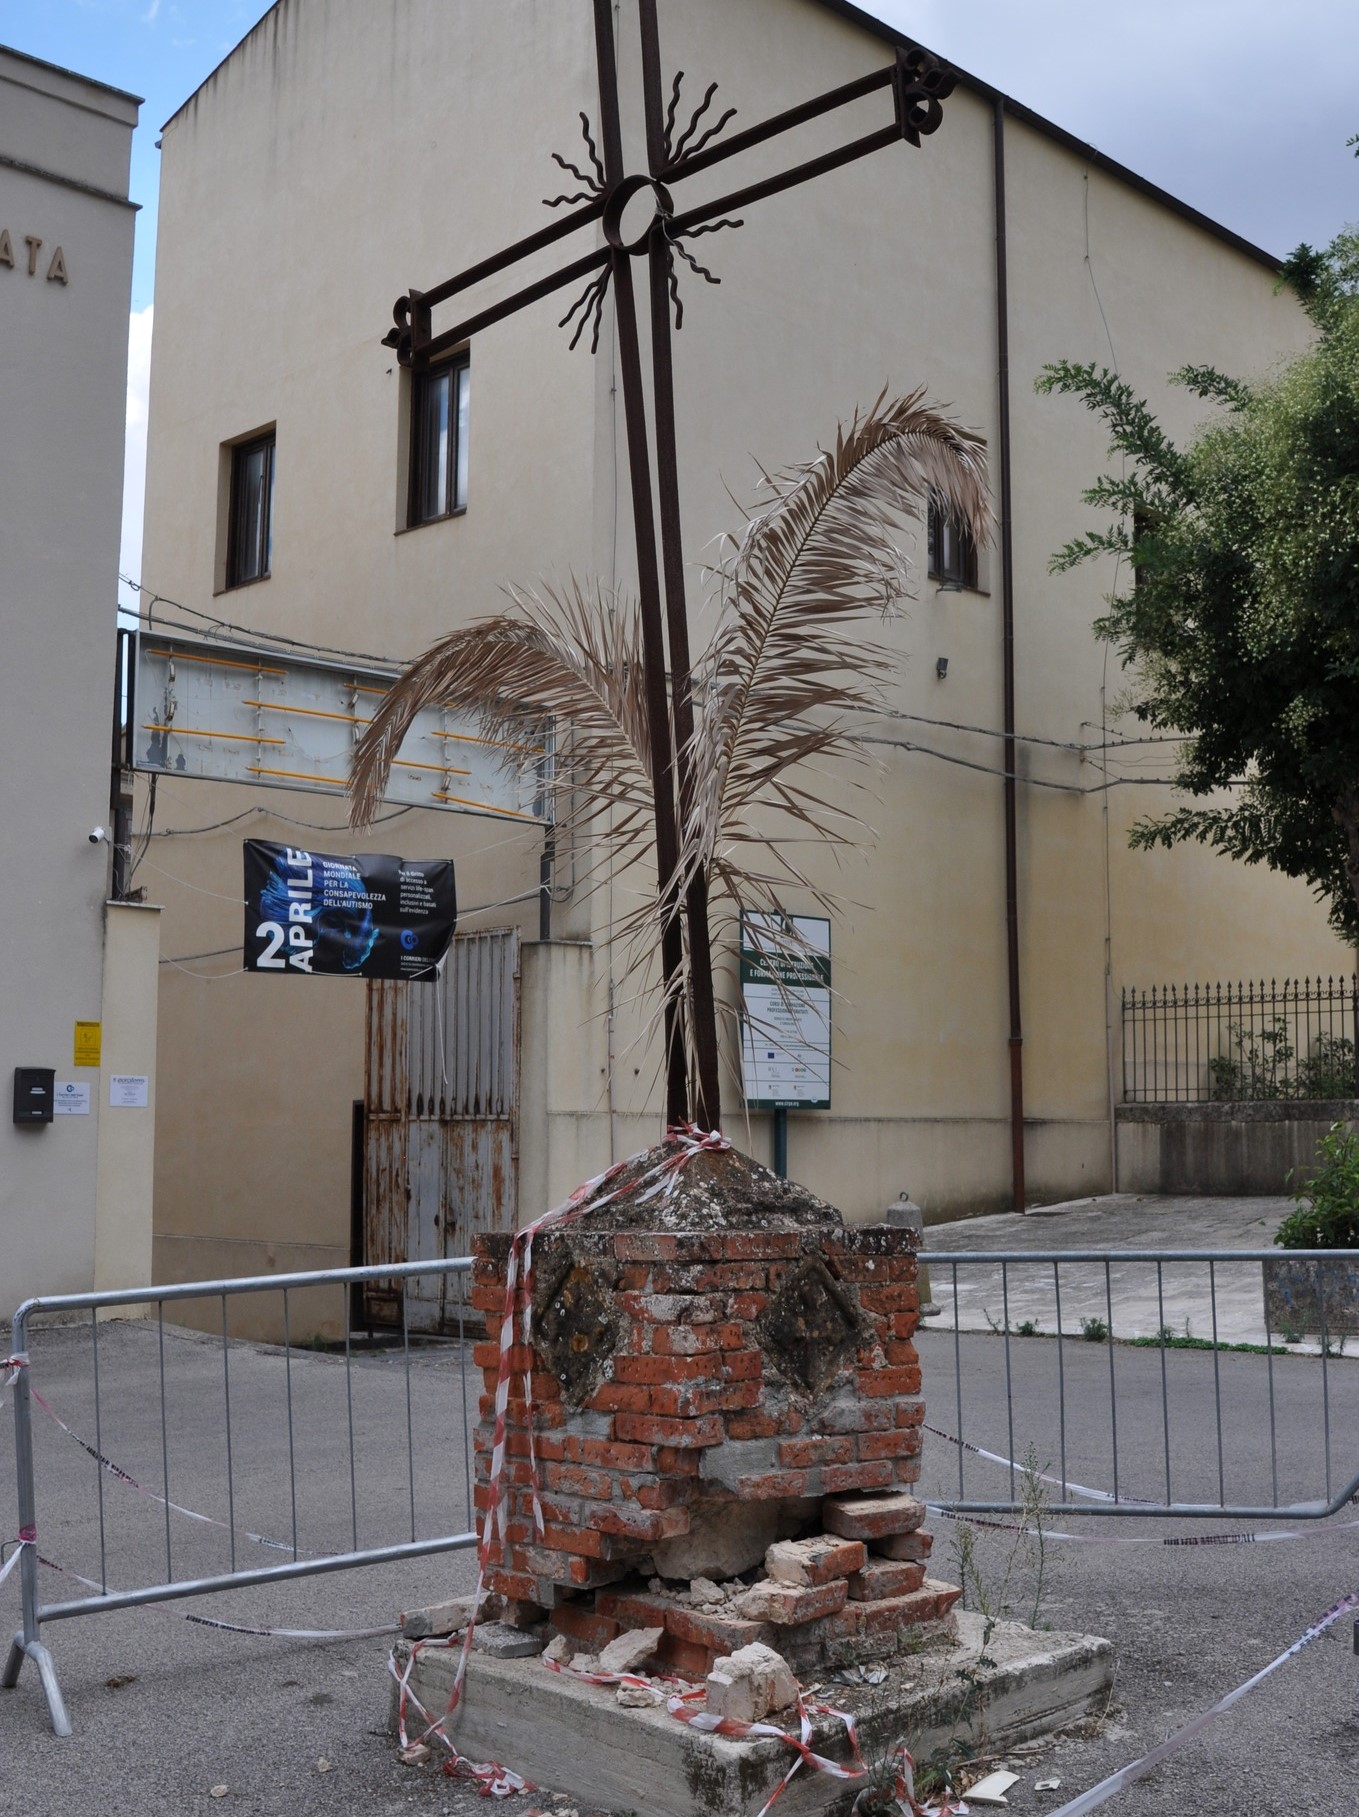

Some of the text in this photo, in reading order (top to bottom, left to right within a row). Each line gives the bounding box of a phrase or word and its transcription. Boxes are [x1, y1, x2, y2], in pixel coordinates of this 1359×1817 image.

[322, 861, 358, 872] GIORNATA
[323, 871, 361, 880] MONDIALE
[324, 880, 349, 889] PER LA
[323, 889, 387, 901] CONSAPEVOLEZZA
[286, 847, 313, 973] APRILE
[323, 899, 373, 910] DELL'AUTISMO
[255, 921, 286, 969] 2
